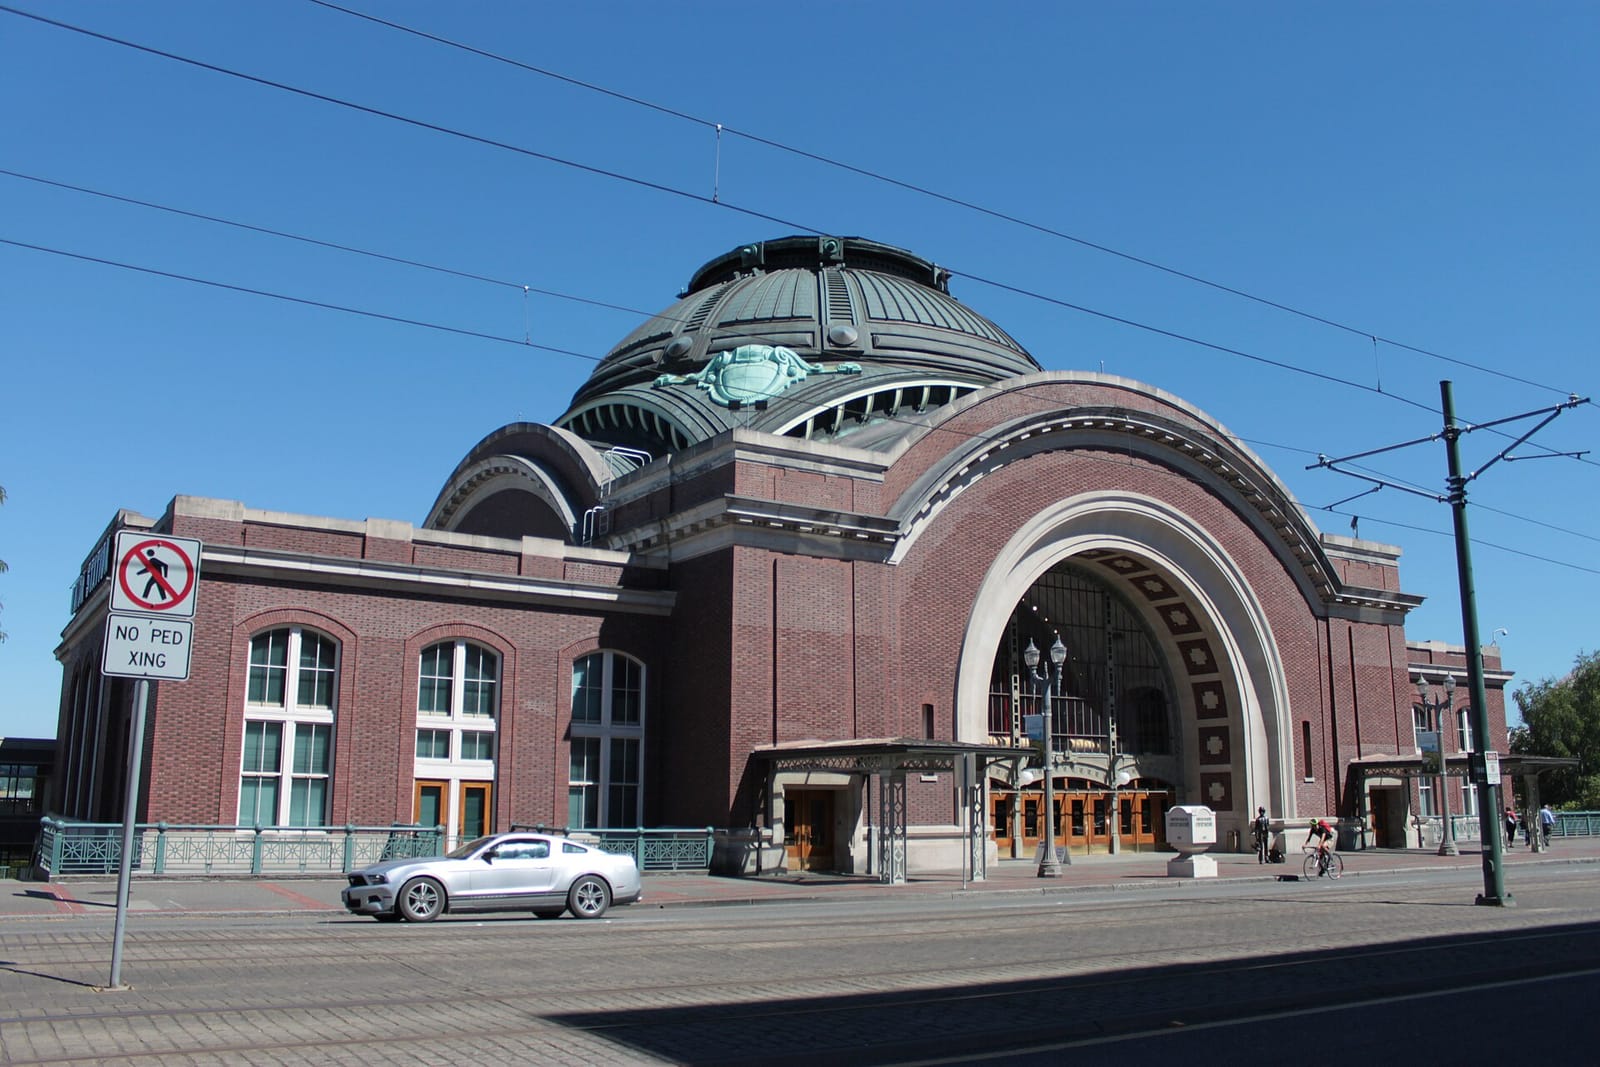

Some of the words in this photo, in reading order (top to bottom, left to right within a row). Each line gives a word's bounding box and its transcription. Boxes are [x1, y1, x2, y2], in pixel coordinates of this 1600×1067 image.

[116, 625, 139, 641] NO
[151, 629, 183, 645] PED
[128, 651, 166, 668] XING
